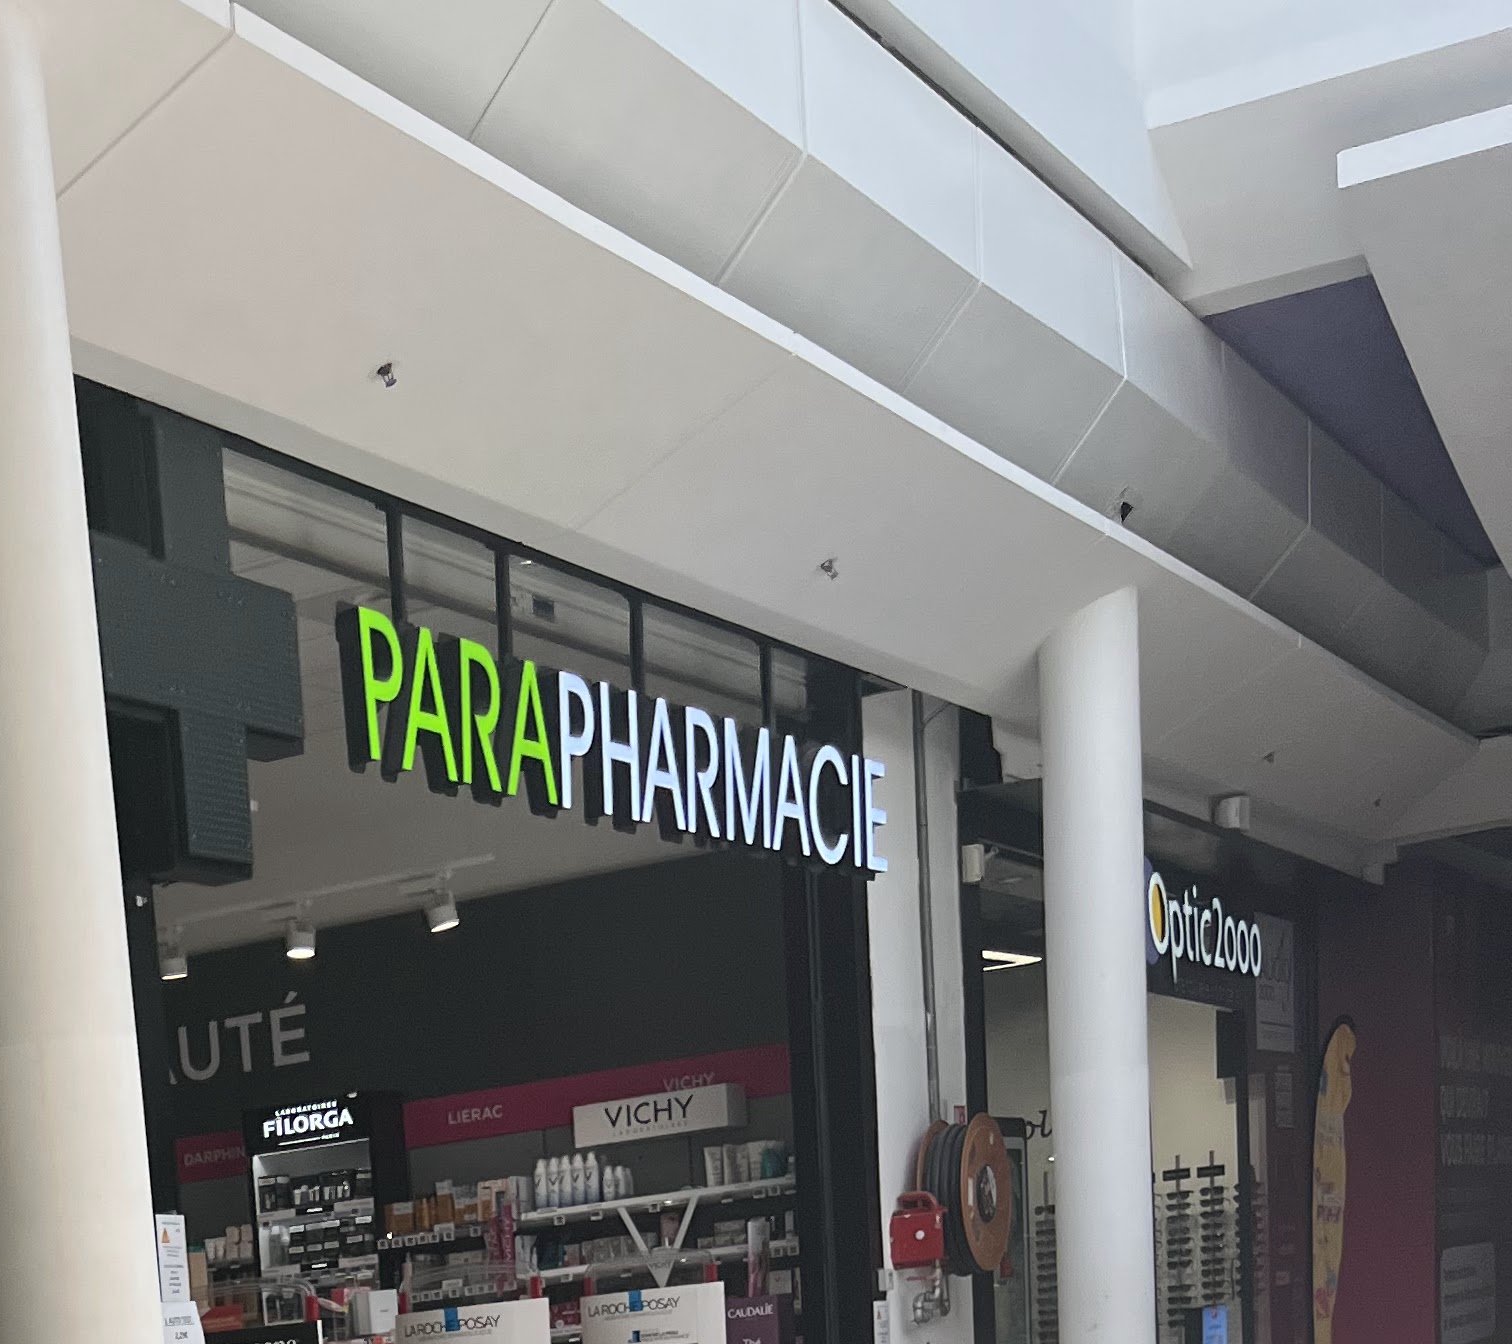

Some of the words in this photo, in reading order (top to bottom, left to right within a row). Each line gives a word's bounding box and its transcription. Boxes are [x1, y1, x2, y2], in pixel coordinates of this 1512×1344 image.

[358, 606, 888, 872] PARAPHARMACIE
[169, 990, 310, 1085] UTÉ
[448, 1104, 503, 1125] LIERAC
[604, 1094, 694, 1128] VICHY
